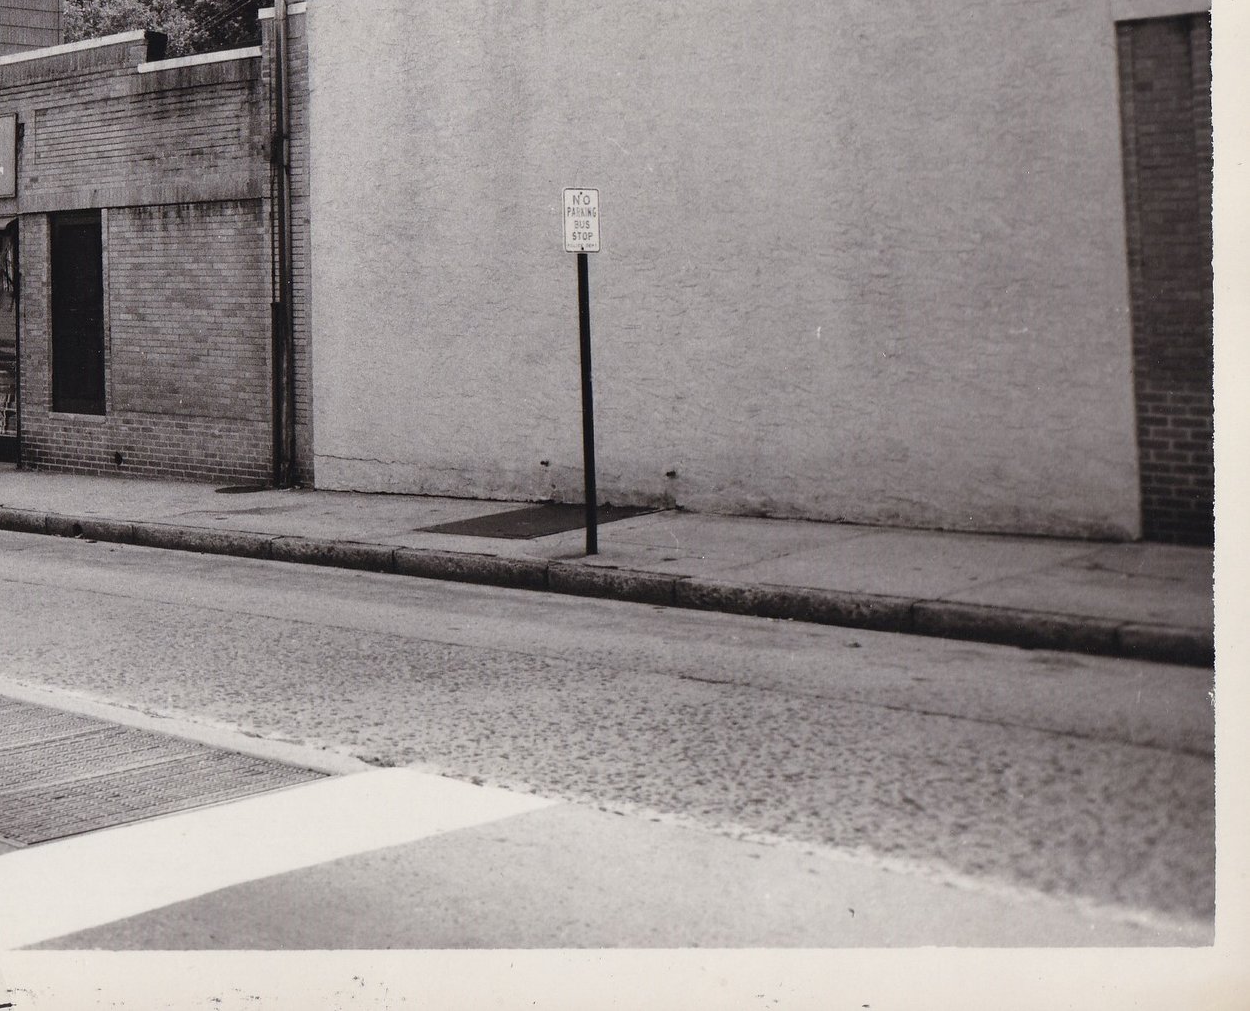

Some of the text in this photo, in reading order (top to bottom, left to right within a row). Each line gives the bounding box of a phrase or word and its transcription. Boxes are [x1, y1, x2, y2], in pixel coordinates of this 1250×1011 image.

[572, 195, 591, 205] NO
[566, 207, 597, 218] PARKING
[573, 220, 590, 229] BUS
[572, 231, 594, 241] STOP
